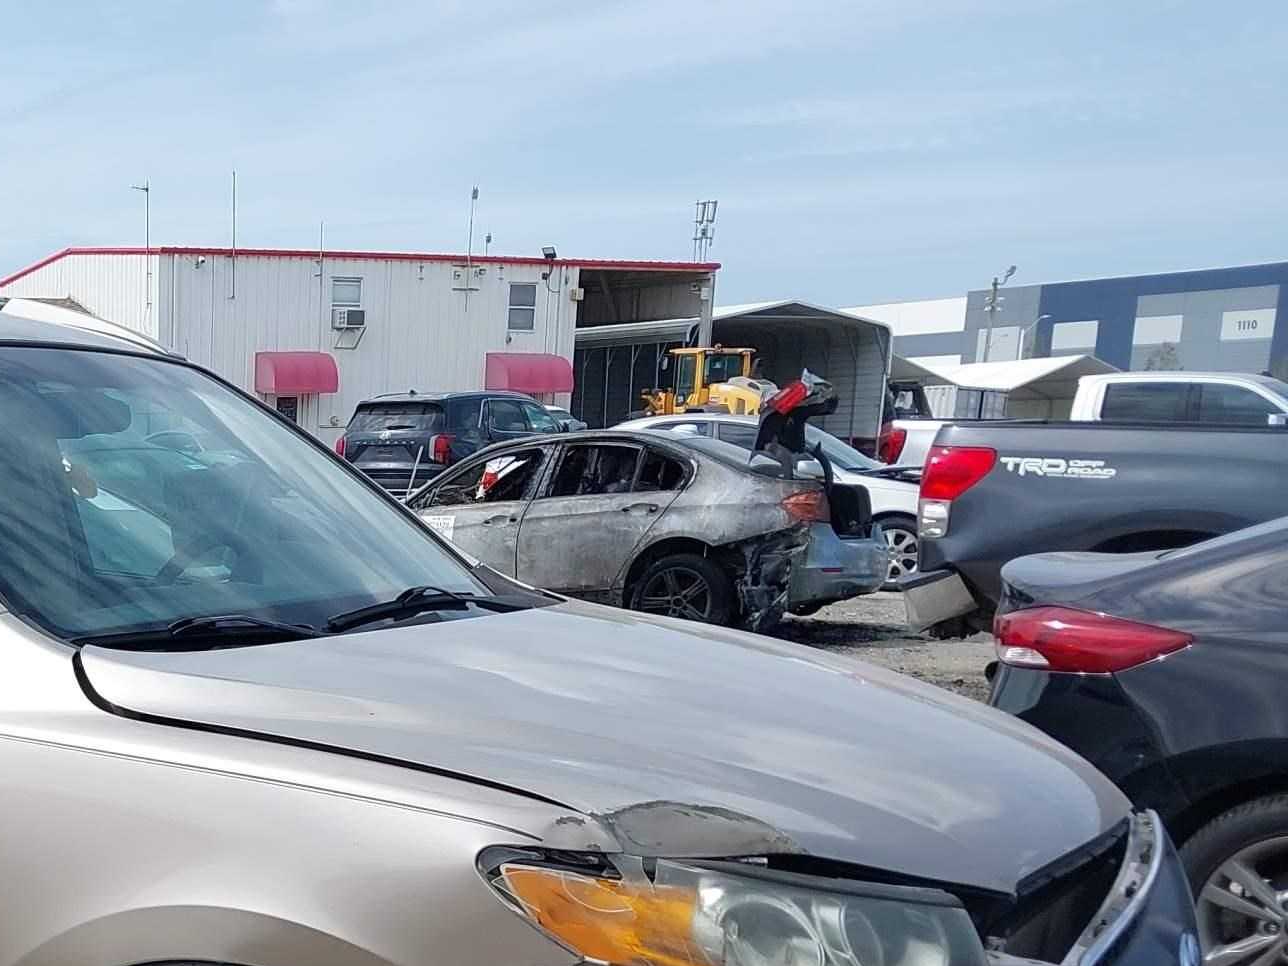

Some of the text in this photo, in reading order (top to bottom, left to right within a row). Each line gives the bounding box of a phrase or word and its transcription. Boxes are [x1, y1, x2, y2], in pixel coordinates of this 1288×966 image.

[1237, 319, 1258, 331] 1110
[999, 456, 1067, 476] TRD
[1067, 467, 1116, 476] ROAD
